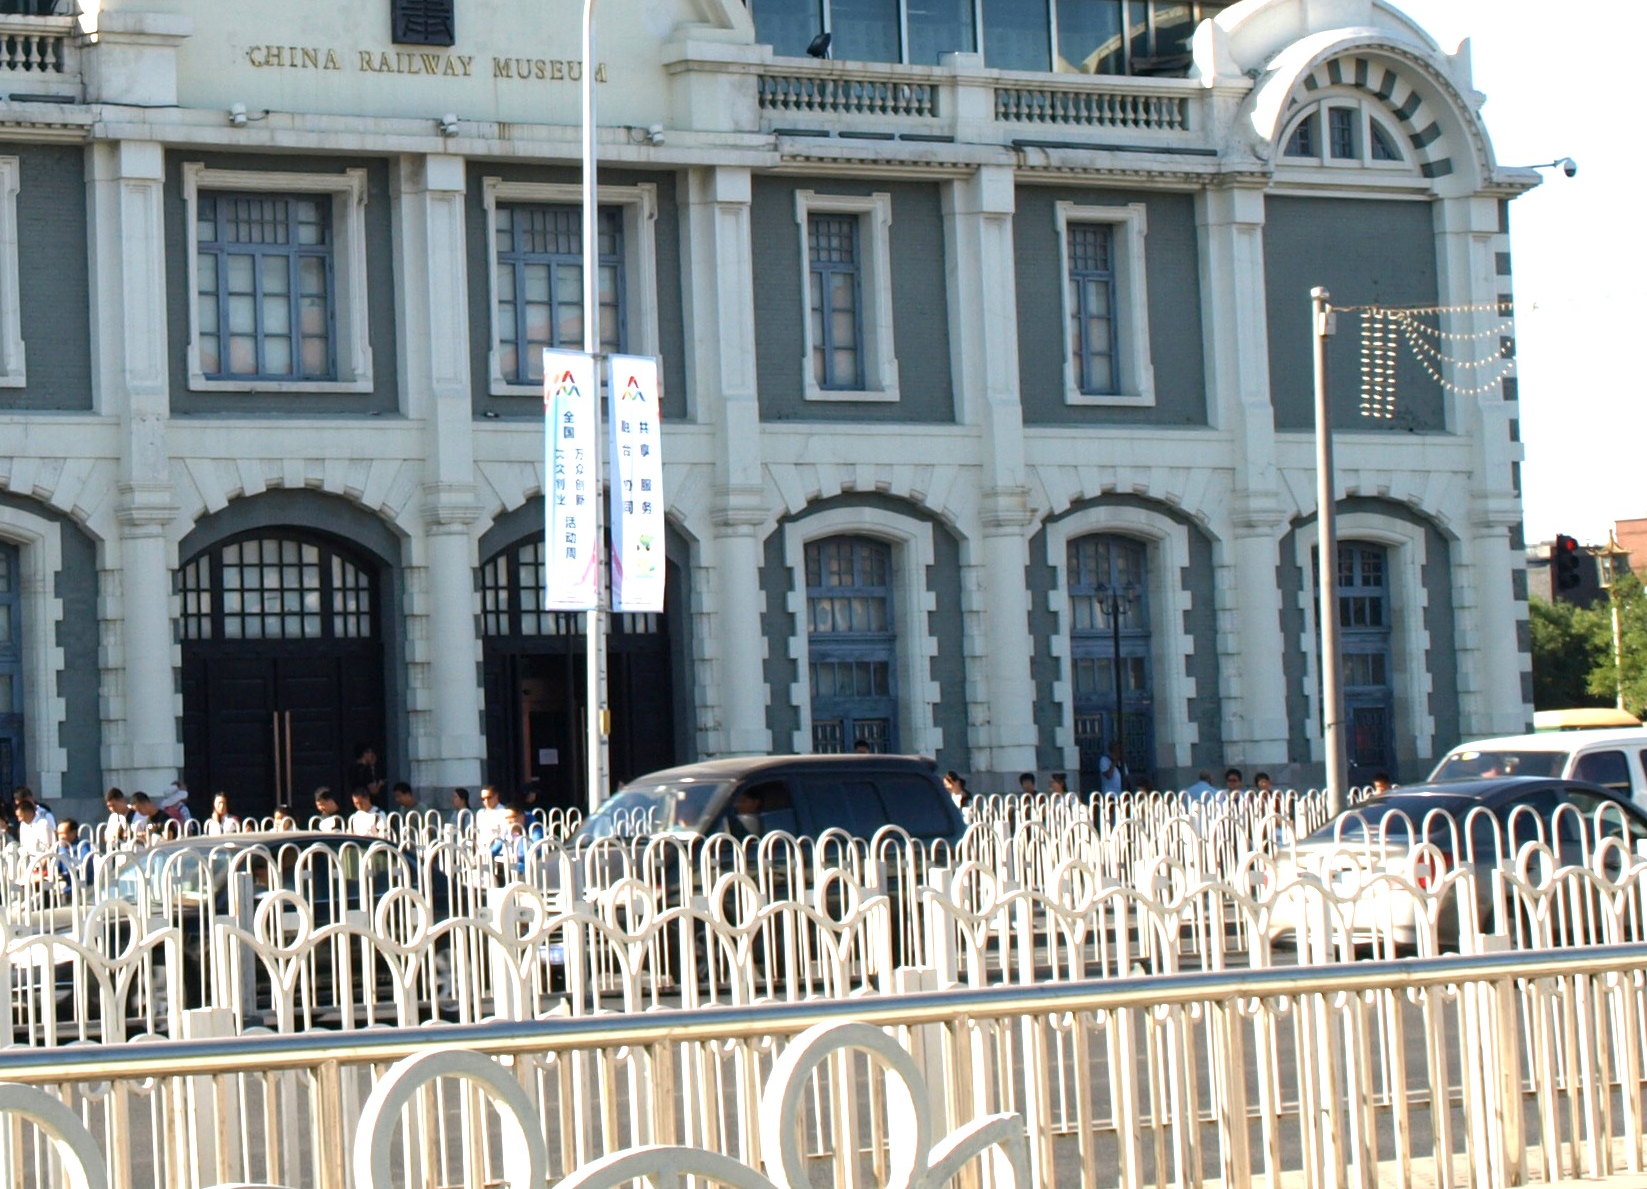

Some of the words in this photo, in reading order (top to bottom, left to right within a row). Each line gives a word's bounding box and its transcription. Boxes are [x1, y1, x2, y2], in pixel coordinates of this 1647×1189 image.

[247, 45, 341, 70] CHINA
[358, 50, 474, 77] RAILWAY
[563, 411, 575, 439] 全国
[565, 516, 577, 560] 活动周
